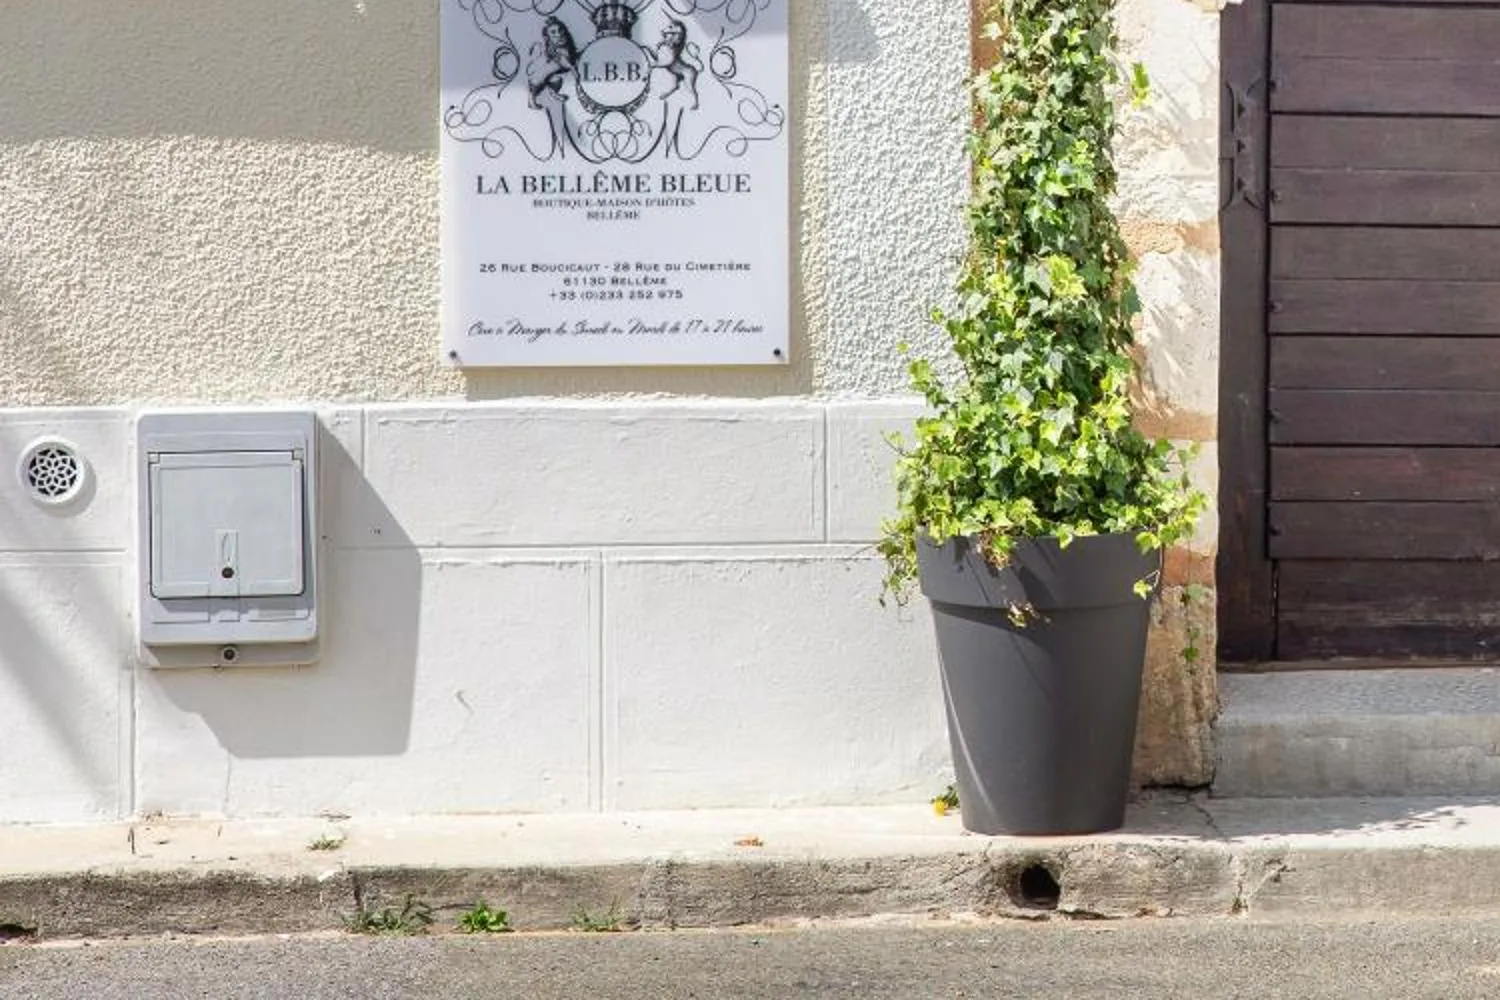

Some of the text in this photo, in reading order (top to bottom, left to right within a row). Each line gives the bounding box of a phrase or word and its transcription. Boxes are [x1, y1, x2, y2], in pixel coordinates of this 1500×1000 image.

[476, 169, 751, 195] LA BELLÊME BLEUE
[480, 264, 497, 272] 26
[501, 264, 526, 272] RUE
[531, 264, 600, 272] BOUCICAUT
[613, 262, 630, 272] 28
[636, 262, 660, 271] RUE
[549, 289, 576, 301] +33
